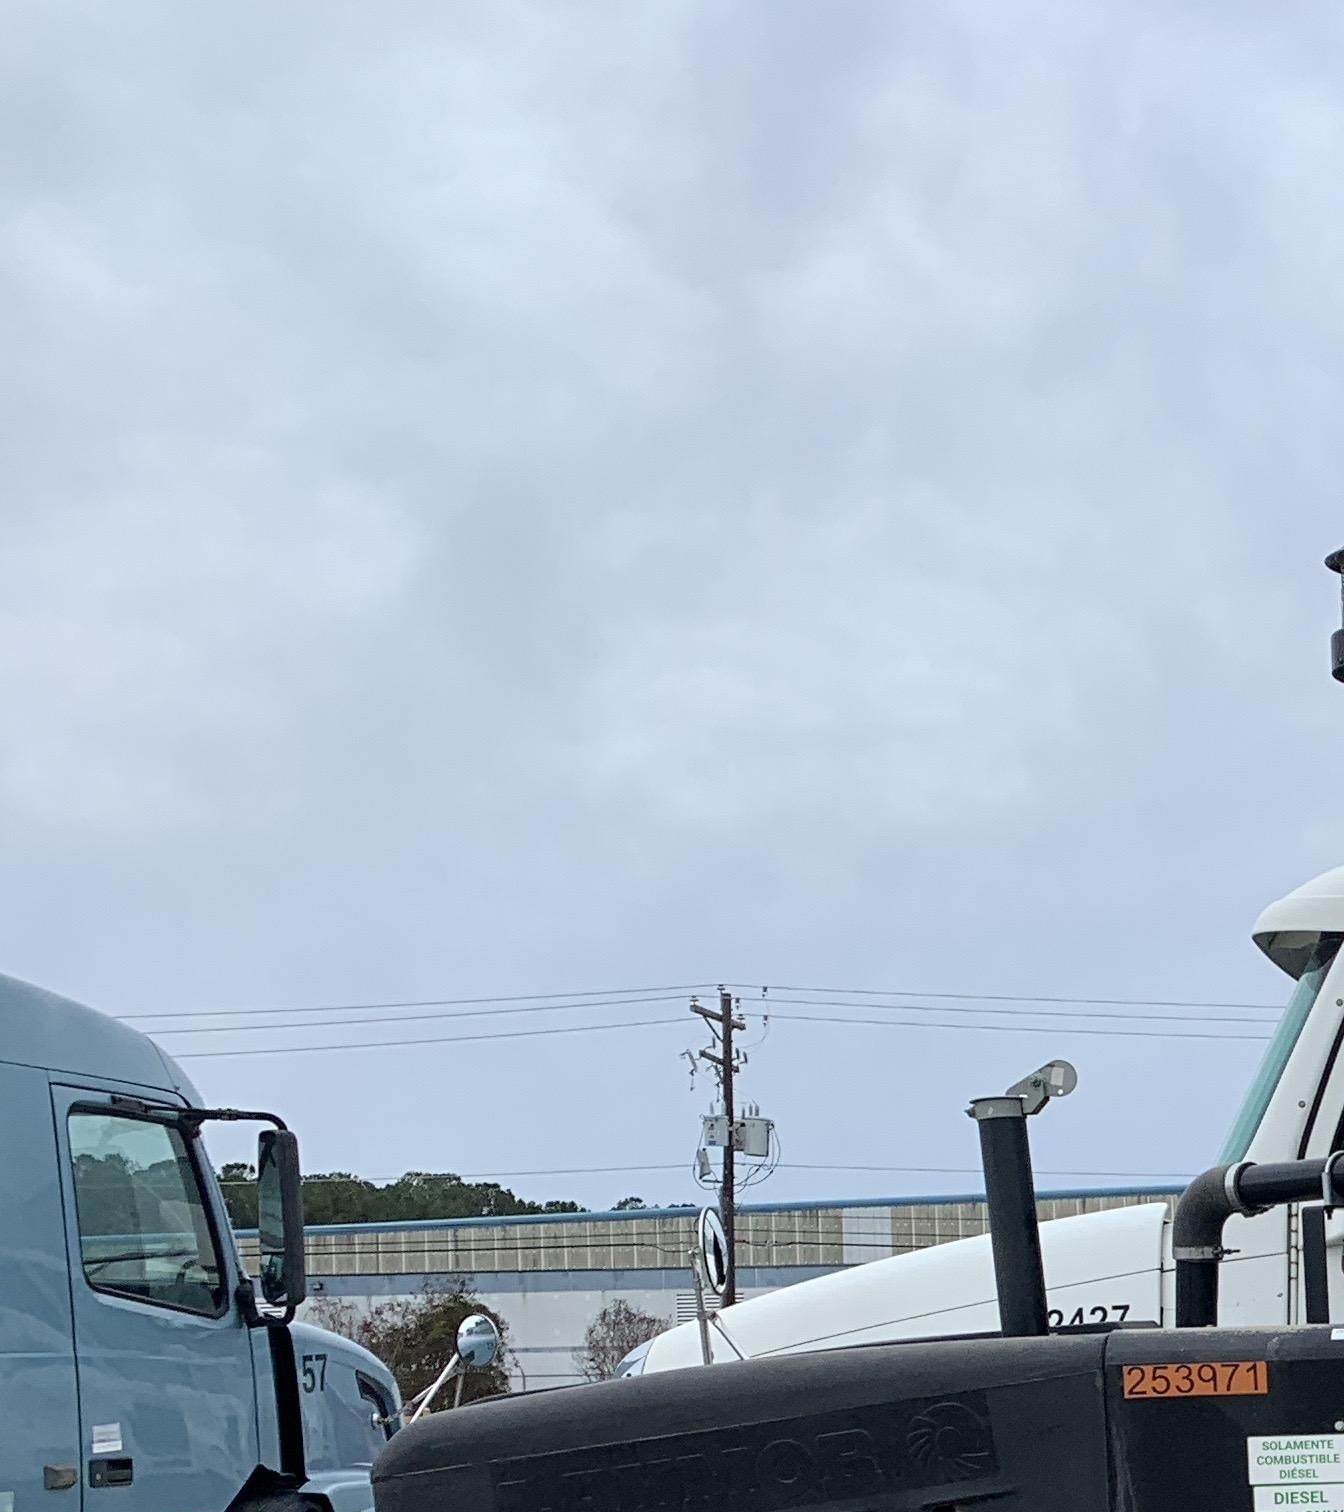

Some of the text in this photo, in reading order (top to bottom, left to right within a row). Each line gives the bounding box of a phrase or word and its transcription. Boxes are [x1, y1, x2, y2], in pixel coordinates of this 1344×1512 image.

[302, 1354, 328, 1393] 57
[1127, 1363, 1259, 1395] 253971
[1262, 1440, 1334, 1451] SOLAMENTE
[1256, 1454, 1341, 1466] COMBUSTIBLE
[1279, 1466, 1319, 1480] DIÉSEL
[1274, 1490, 1329, 1505] DIESEL
